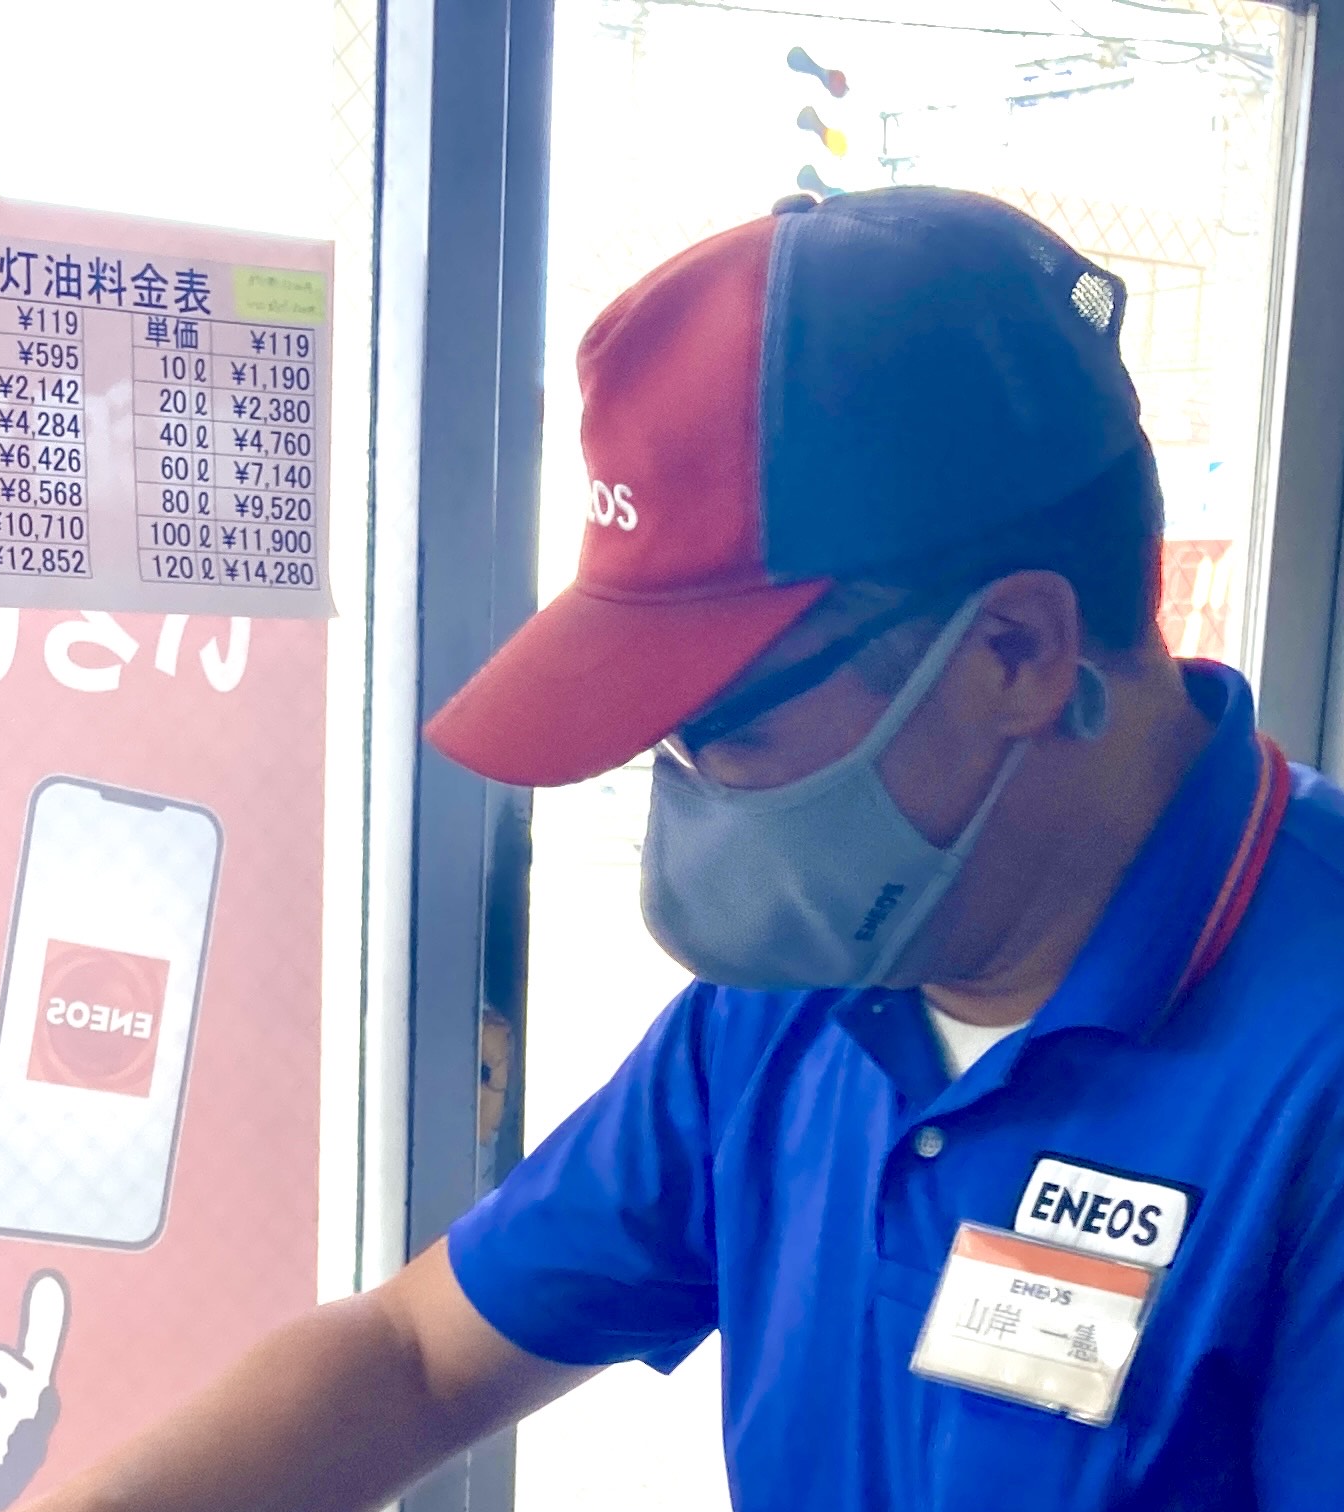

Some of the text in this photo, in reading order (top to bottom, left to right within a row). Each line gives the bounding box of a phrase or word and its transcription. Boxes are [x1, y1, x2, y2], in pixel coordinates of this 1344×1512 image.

[17, 307, 79, 335] ¥119
[145, 318, 310, 358] 単価 ¥119
[18, 342, 80, 370] ¥595
[160, 356, 187, 380] 10
[231, 361, 310, 391] ¥1,190
[159, 389, 187, 414] 20
[231, 394, 311, 426] ¥2,380
[160, 423, 188, 448] 40
[233, 428, 312, 459] ¥4,760
[160, 456, 188, 481] 60
[234, 460, 312, 491] ¥7,140
[0, 478, 83, 508] ¥8,568
[161, 490, 189, 514] 80
[234, 494, 313, 523] ¥9,520
[150, 523, 191, 547] 100
[222, 527, 312, 557] ¥11,900
[152, 556, 194, 579] 120
[223, 558, 315, 588] ¥14,280
[1030, 1182, 1163, 1247] ENEOS
